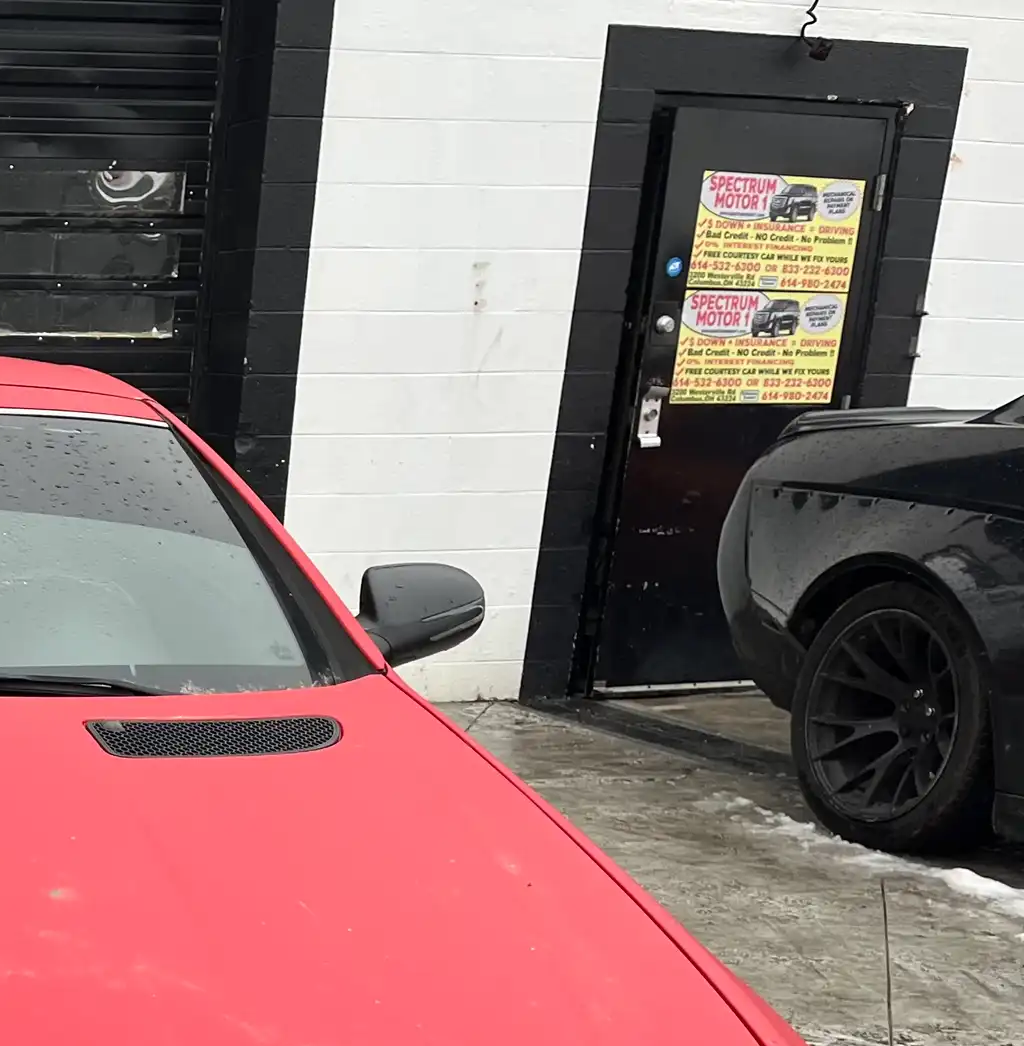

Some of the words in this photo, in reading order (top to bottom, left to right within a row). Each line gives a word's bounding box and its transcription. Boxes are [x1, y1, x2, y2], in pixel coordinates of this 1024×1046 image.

[710, 176, 778, 194] SPECTRUM
[714, 192, 759, 210] MOTOR
[762, 196, 768, 210] 1
[716, 220, 744, 229] DOWN
[753, 222, 806, 233] INSURANCE
[818, 226, 854, 235] DRIVING
[706, 230, 721, 239] Bad
[724, 231, 748, 239] Credit
[770, 234, 794, 242] Credit
[814, 236, 845, 244] Problem
[766, 243, 813, 252] FINANCING
[690, 261, 761, 272] 614-532-6300
[783, 264, 849, 276] 833-232-6300
[780, 278, 846, 289] 614-980-2474
[690, 294, 760, 310] SPECTRUM
[696, 311, 741, 327] MOTOR
[744, 314, 750, 327] 1
[735, 339, 788, 347] INSURANCE
[800, 339, 836, 347] DRIVING
[688, 348, 703, 356] Bad
[706, 348, 730, 356] Credit
[672, 378, 742, 387] 614-532-6300
[762, 392, 829, 400] 614-980-2474
